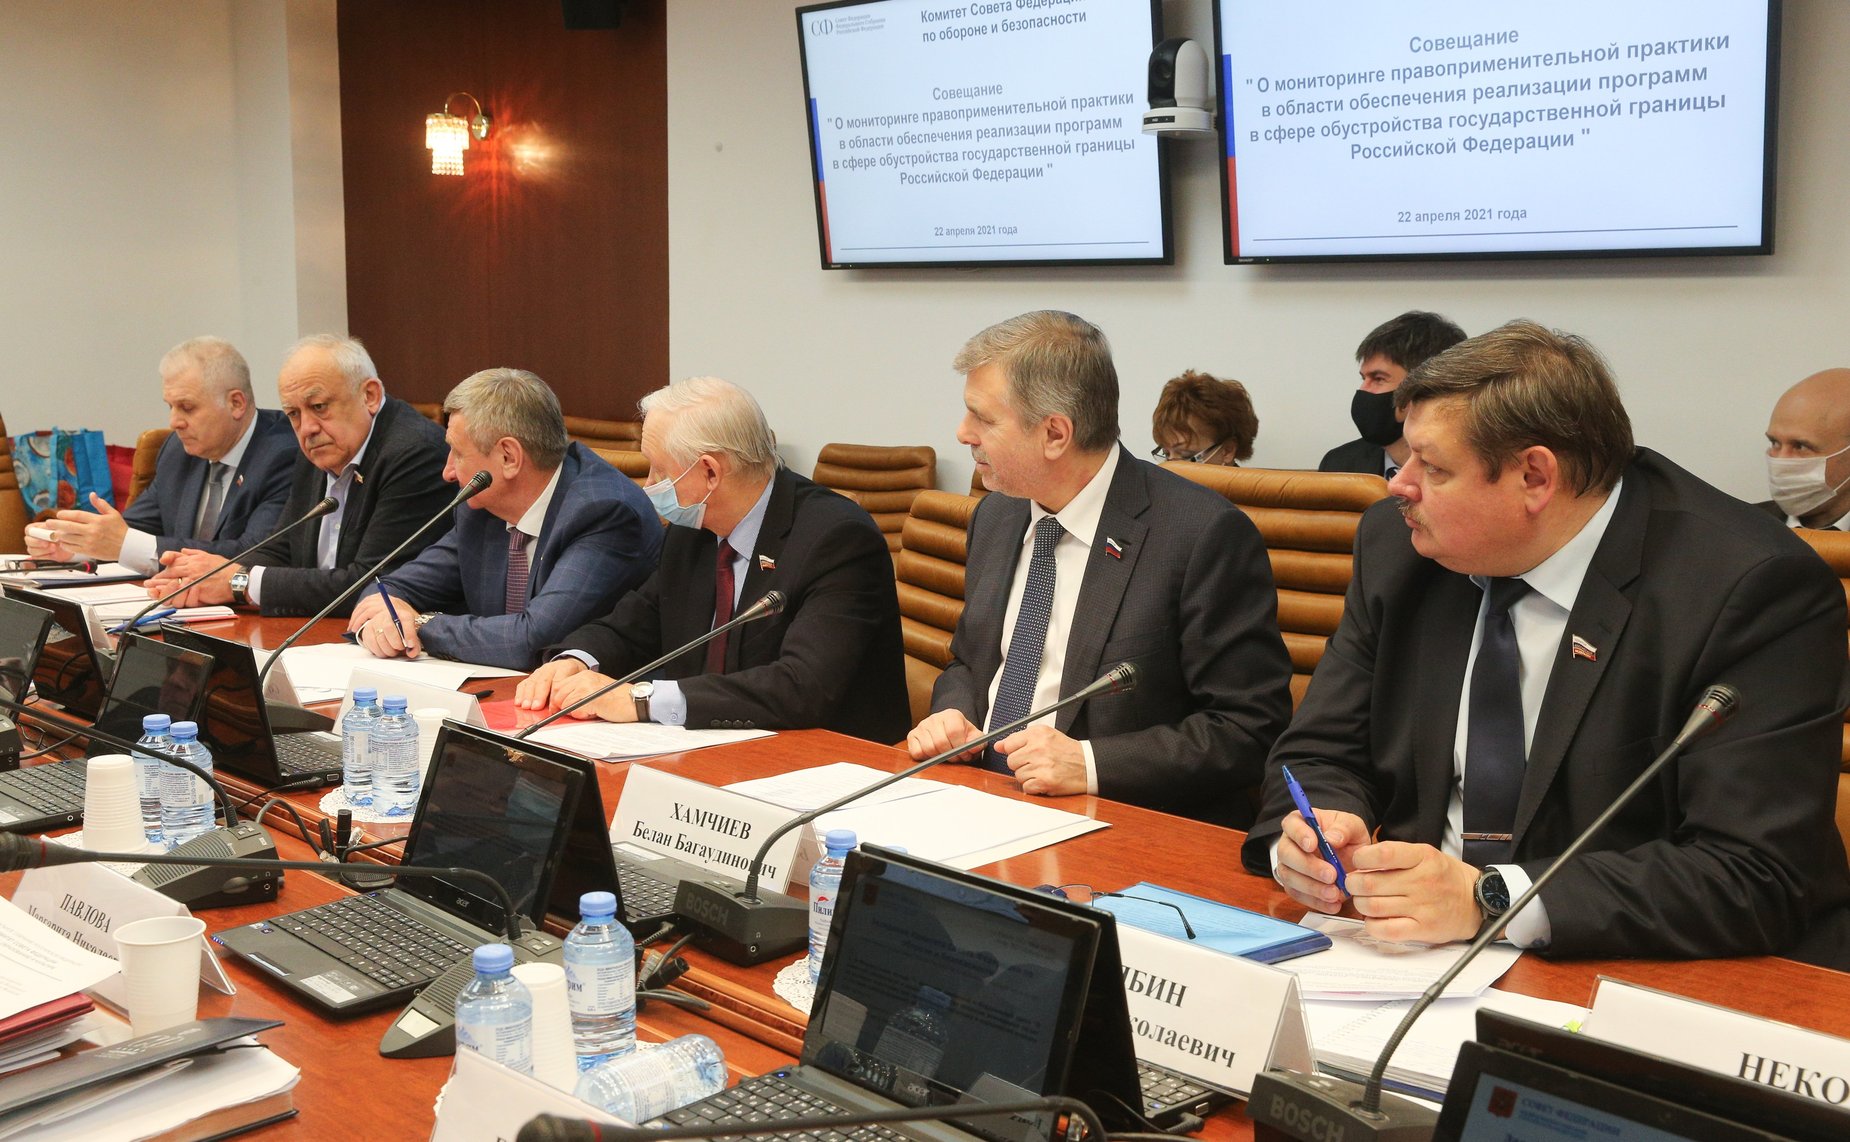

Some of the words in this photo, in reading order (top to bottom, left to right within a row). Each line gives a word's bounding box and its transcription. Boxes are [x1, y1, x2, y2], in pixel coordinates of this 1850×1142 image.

[921, 8, 967, 23] Комитет
[970, 1, 1013, 16] Совета
[1016, 0, 1084, 9] Федера
[923, 32, 936, 42] по
[939, 25, 987, 41] обороне
[991, 24, 998, 33] и
[1001, 12, 1086, 32] безопасности
[1410, 30, 1518, 53] Совещание
[1258, 77, 1269, 93] О
[1275, 70, 1385, 91] мониторинге
[1391, 43, 1619, 81] правоприменительной
[1628, 35, 1729, 62] практики
[933, 84, 1003, 100] Совещание
[1262, 106, 1271, 117] в
[1276, 99, 1343, 116] области
[1349, 89, 1466, 110] обеспечения
[1473, 78, 1591, 104] реализации
[1599, 67, 1707, 93] программ
[835, 117, 843, 130] О
[847, 113, 919, 128] мониторинге
[922, 98, 1066, 123] правоприменительной
[1071, 93, 1133, 112] практики
[1250, 131, 1259, 142] в
[1264, 125, 1315, 144] сфере
[1321, 116, 1442, 140] обустройства
[1449, 98, 1621, 130] государственной
[1630, 95, 1725, 119] границы
[840, 140, 846, 149] в
[849, 136, 893, 150] области
[897, 130, 972, 145] обеспечения
[976, 123, 1051, 143] реализации
[1055, 117, 1122, 136] программ
[1351, 138, 1456, 159] Российской
[1463, 134, 1574, 154] Федерации
[833, 160, 839, 169] в
[842, 156, 876, 171] сфере
[879, 151, 959, 169] обустройства
[962, 140, 1071, 163] государственной
[1076, 139, 1134, 156] границы
[900, 169, 968, 184] Российской
[972, 167, 1043, 182] Федерации
[934, 227, 943, 236] 22
[946, 228, 975, 238] апреля
[977, 225, 995, 235] 2021
[999, 226, 1017, 235] года
[1398, 211, 1411, 222] 22
[1415, 212, 1460, 224] апреля
[1465, 208, 1492, 220] 2021
[1498, 210, 1526, 221] года
[670, 803, 752, 840] ХАМЧИЕВ
[632, 820, 673, 847] Белан
[674, 833, 777, 879] Багаудиноич
[60, 893, 112, 933] ПАВЛОВА
[455, 897, 470, 908] acer
[686, 892, 729, 926] BOSCH
[907, 1082, 930, 1097] acer
[1270, 1093, 1345, 1142] BOSCH
